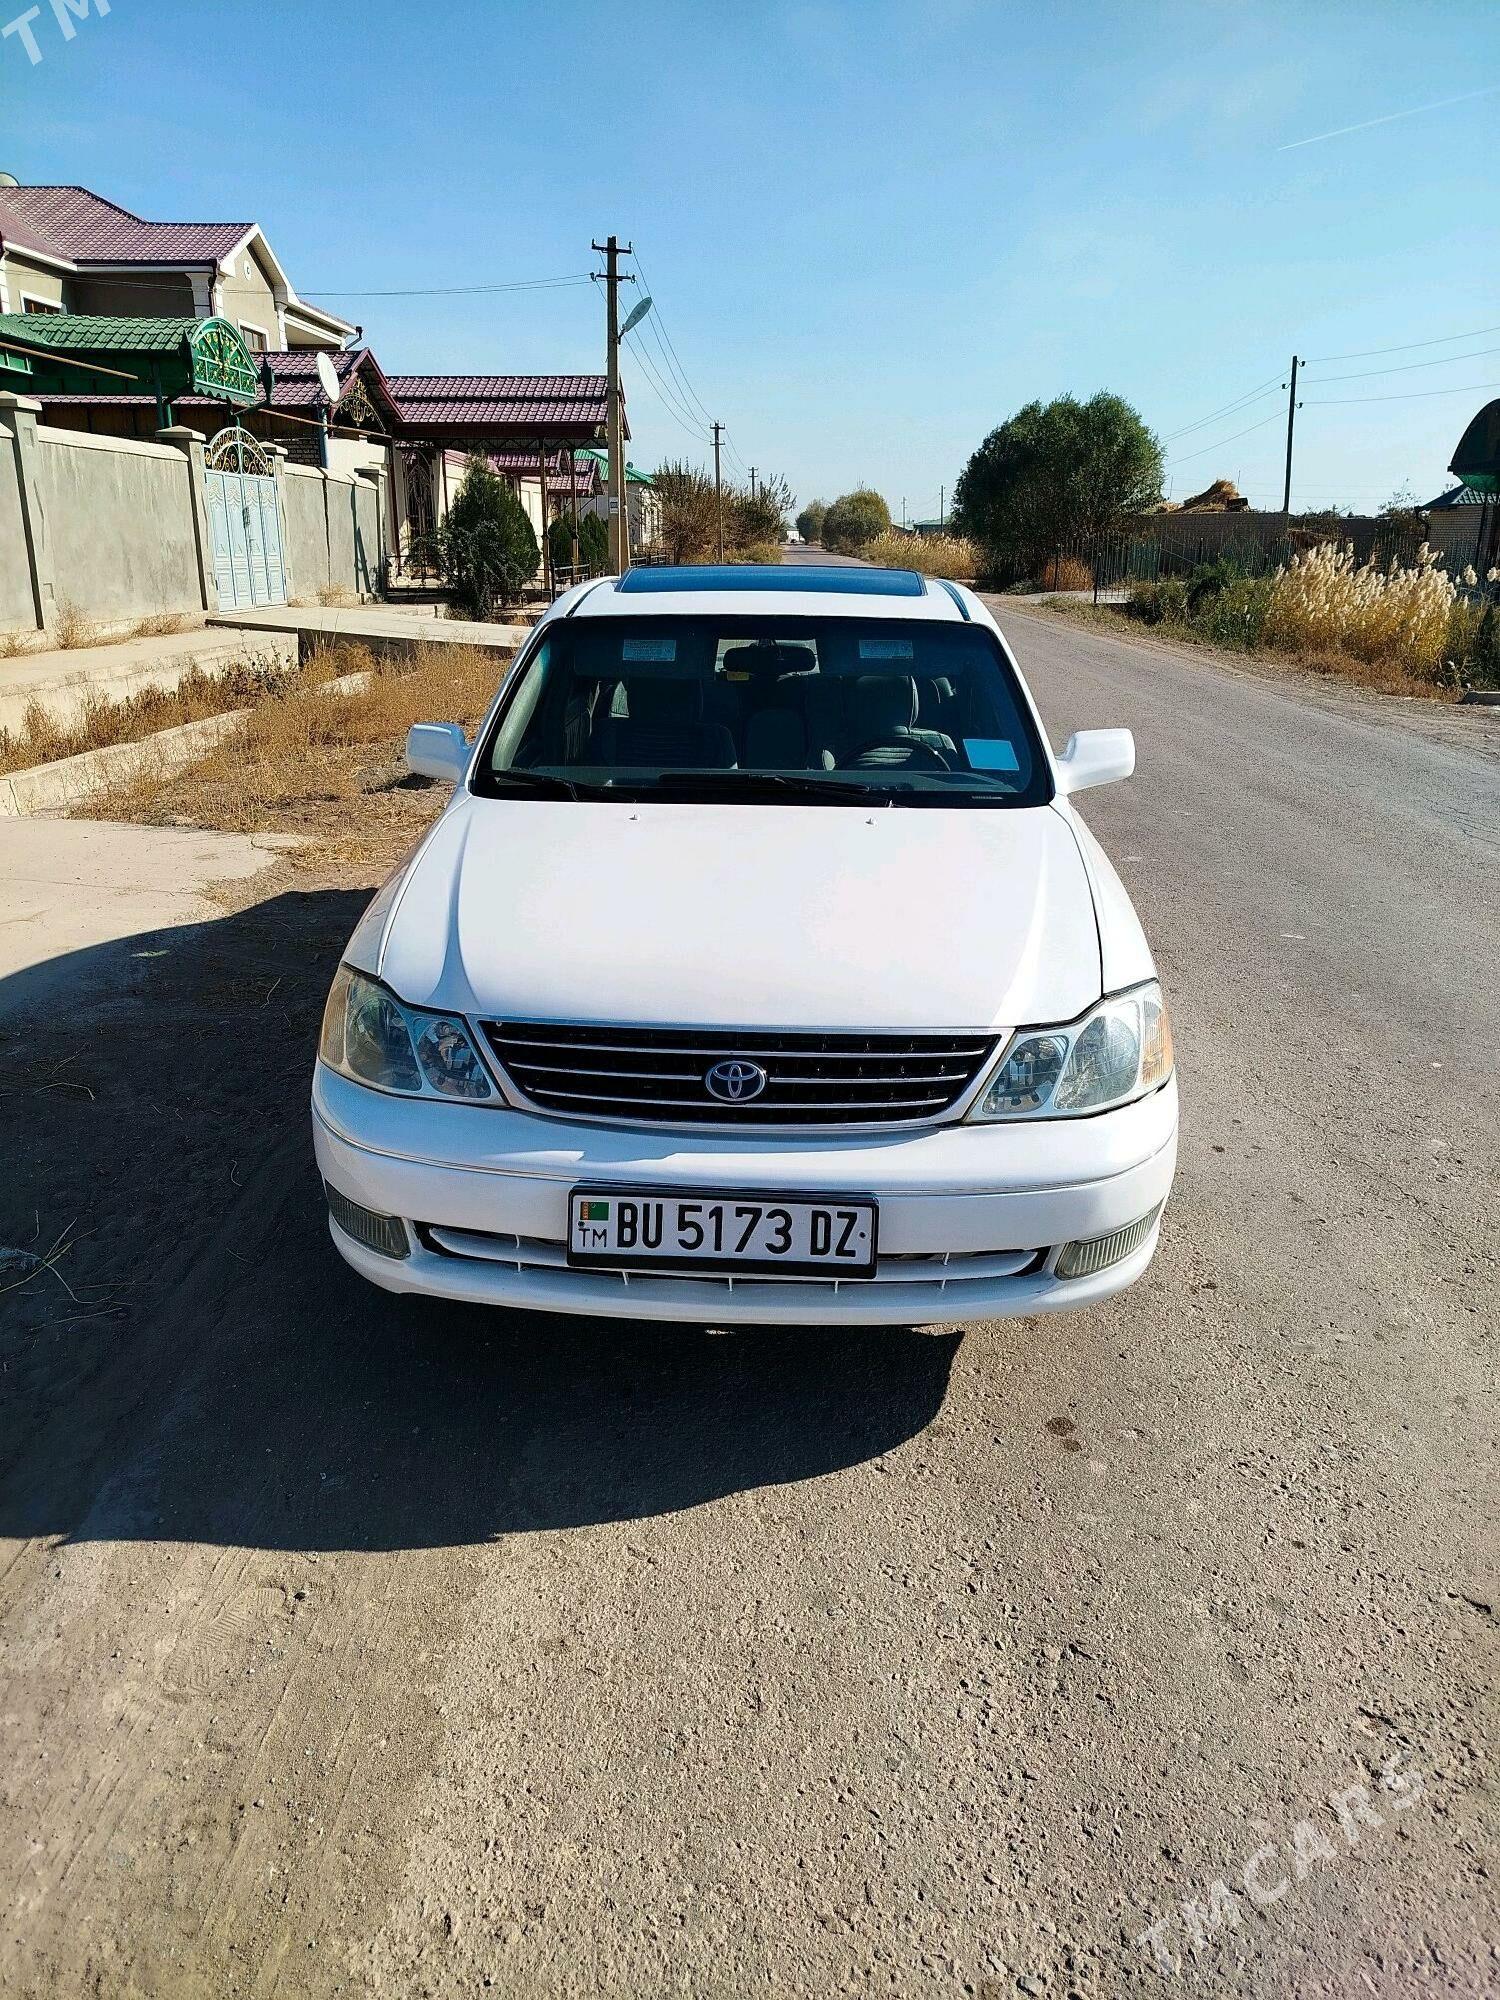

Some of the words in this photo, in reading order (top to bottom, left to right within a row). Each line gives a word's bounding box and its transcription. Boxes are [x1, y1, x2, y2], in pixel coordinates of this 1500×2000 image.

[578, 1228, 607, 1248] TM
[617, 1202, 663, 1249] BU
[677, 1204, 793, 1254] 5173
[810, 1209, 858, 1257] DZ
